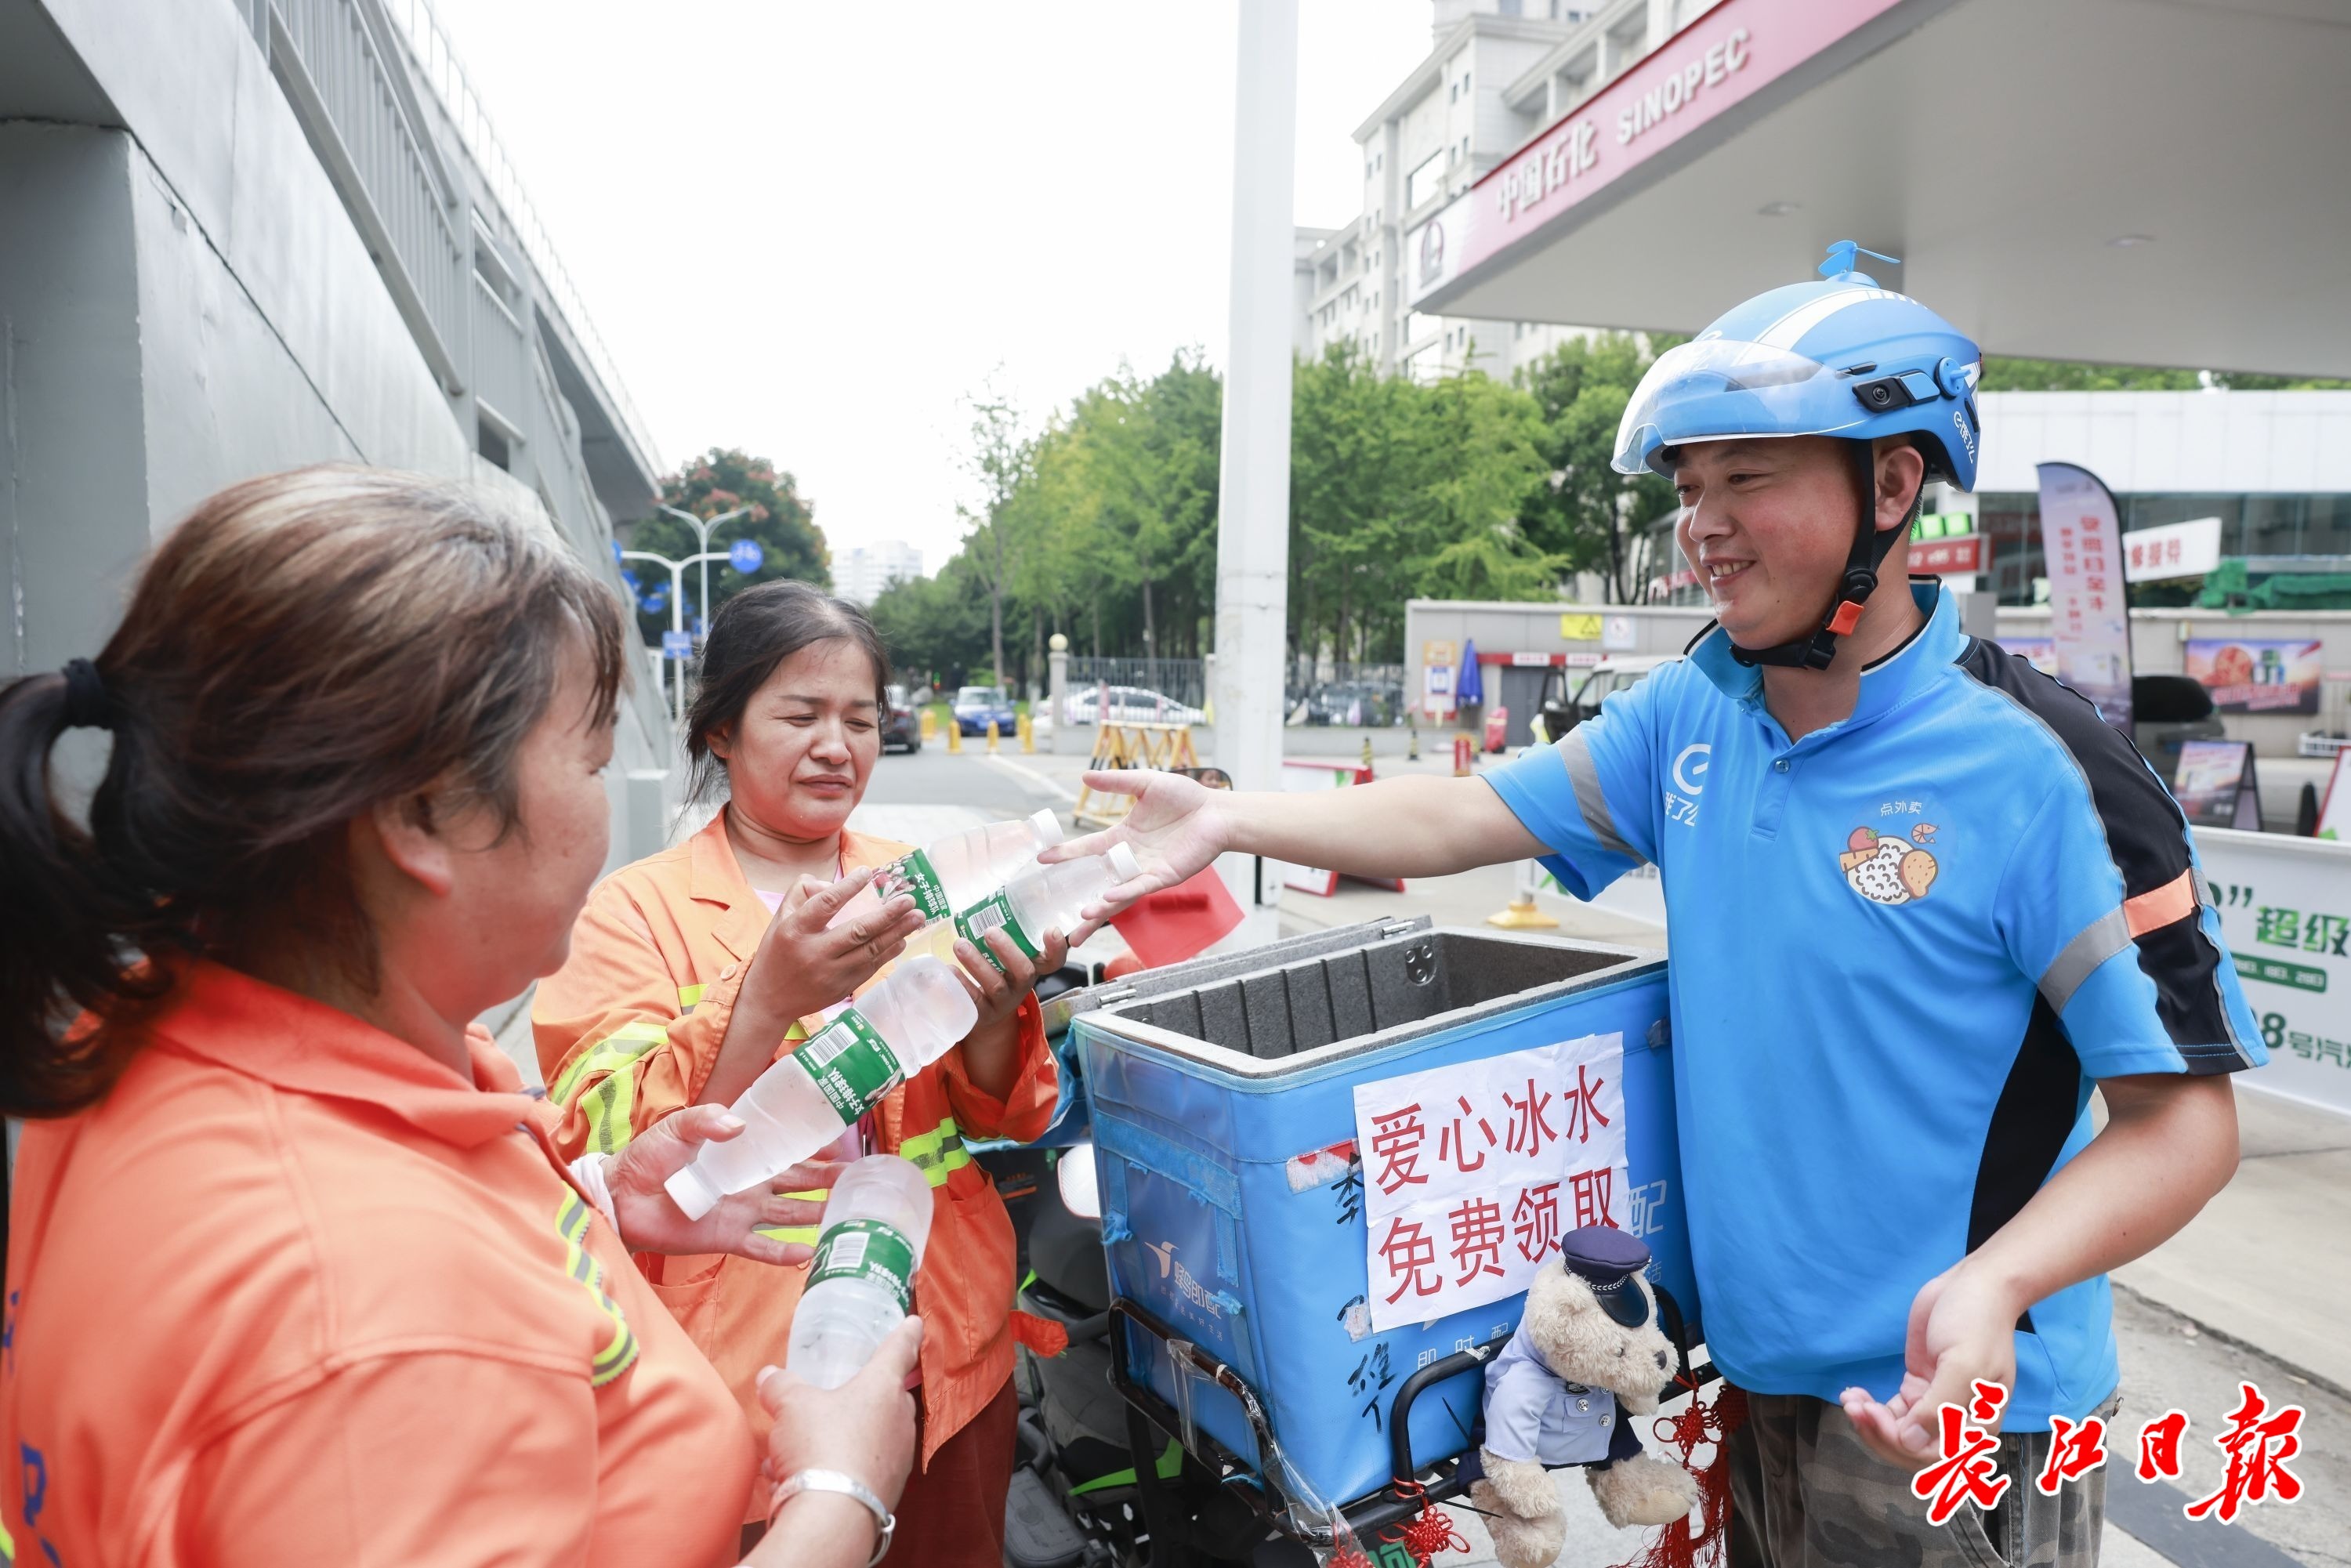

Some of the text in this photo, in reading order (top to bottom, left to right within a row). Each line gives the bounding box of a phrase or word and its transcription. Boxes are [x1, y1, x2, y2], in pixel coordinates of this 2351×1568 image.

[1498, 27, 1751, 223] 中国石化 SINOPEC
[1881, 800, 1922, 817] 点外卖
[2251, 1008, 2351, 1068] 8号汽
[817, 1076, 844, 1110] 中国国家
[828, 1067, 865, 1116] 女子排球队
[1371, 1065, 1610, 1196] 爱心冰水
[1378, 1166, 1620, 1305] 免费领取
